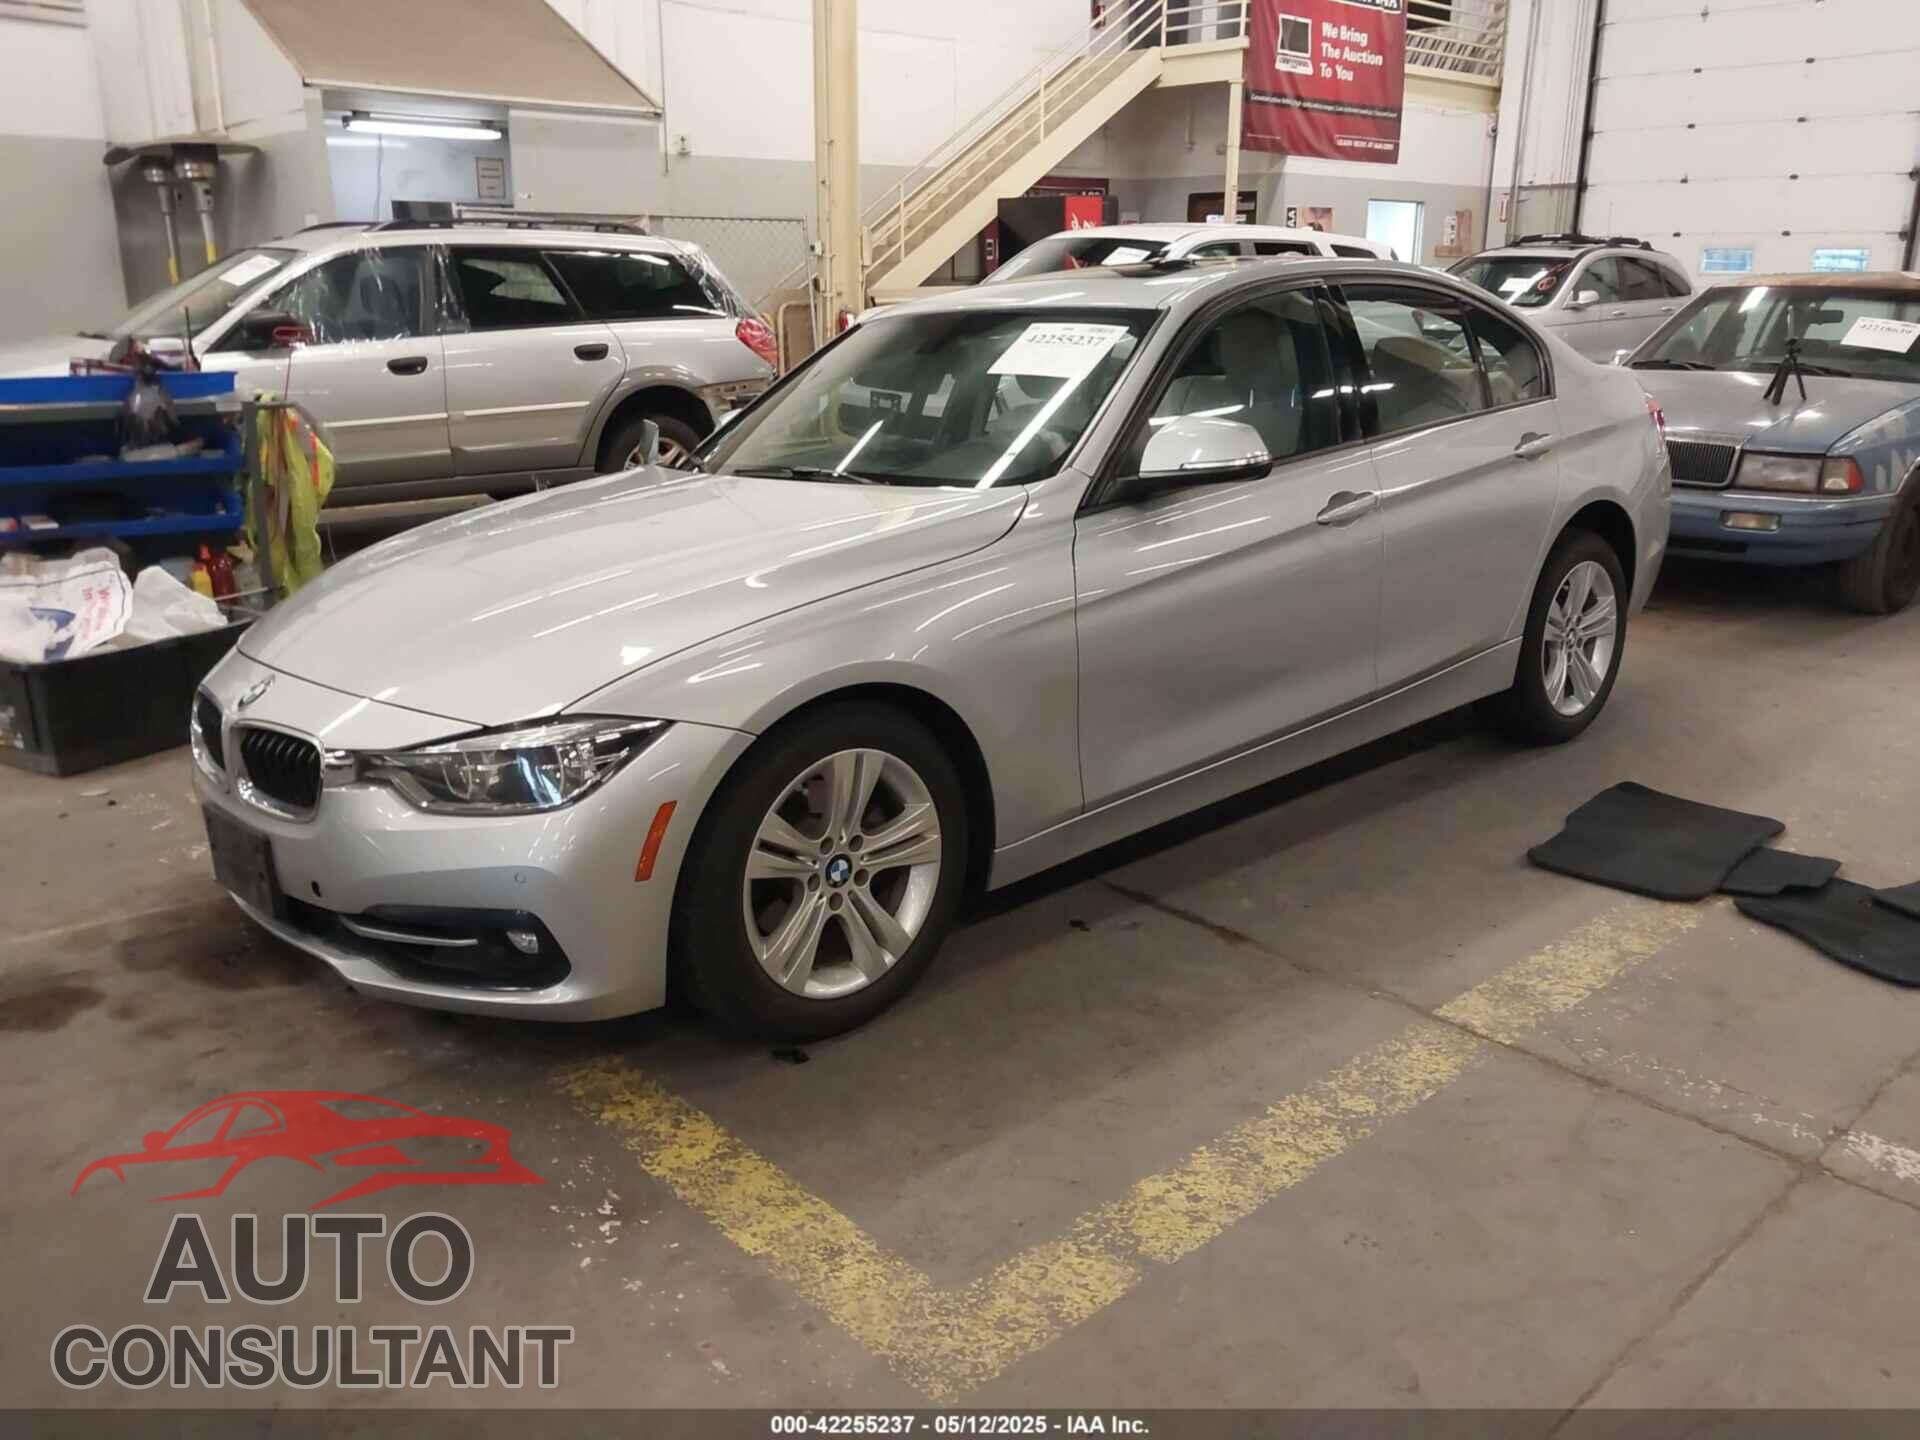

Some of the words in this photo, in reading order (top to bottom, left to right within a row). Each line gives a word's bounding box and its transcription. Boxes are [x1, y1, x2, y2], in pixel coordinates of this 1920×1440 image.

[1322, 22, 1338, 39] We
[1340, 25, 1368, 47] Bring
[1321, 43, 1341, 60] The
[1343, 49, 1383, 66] Auction
[1320, 63, 1332, 78] To
[1335, 65, 1353, 81] You
